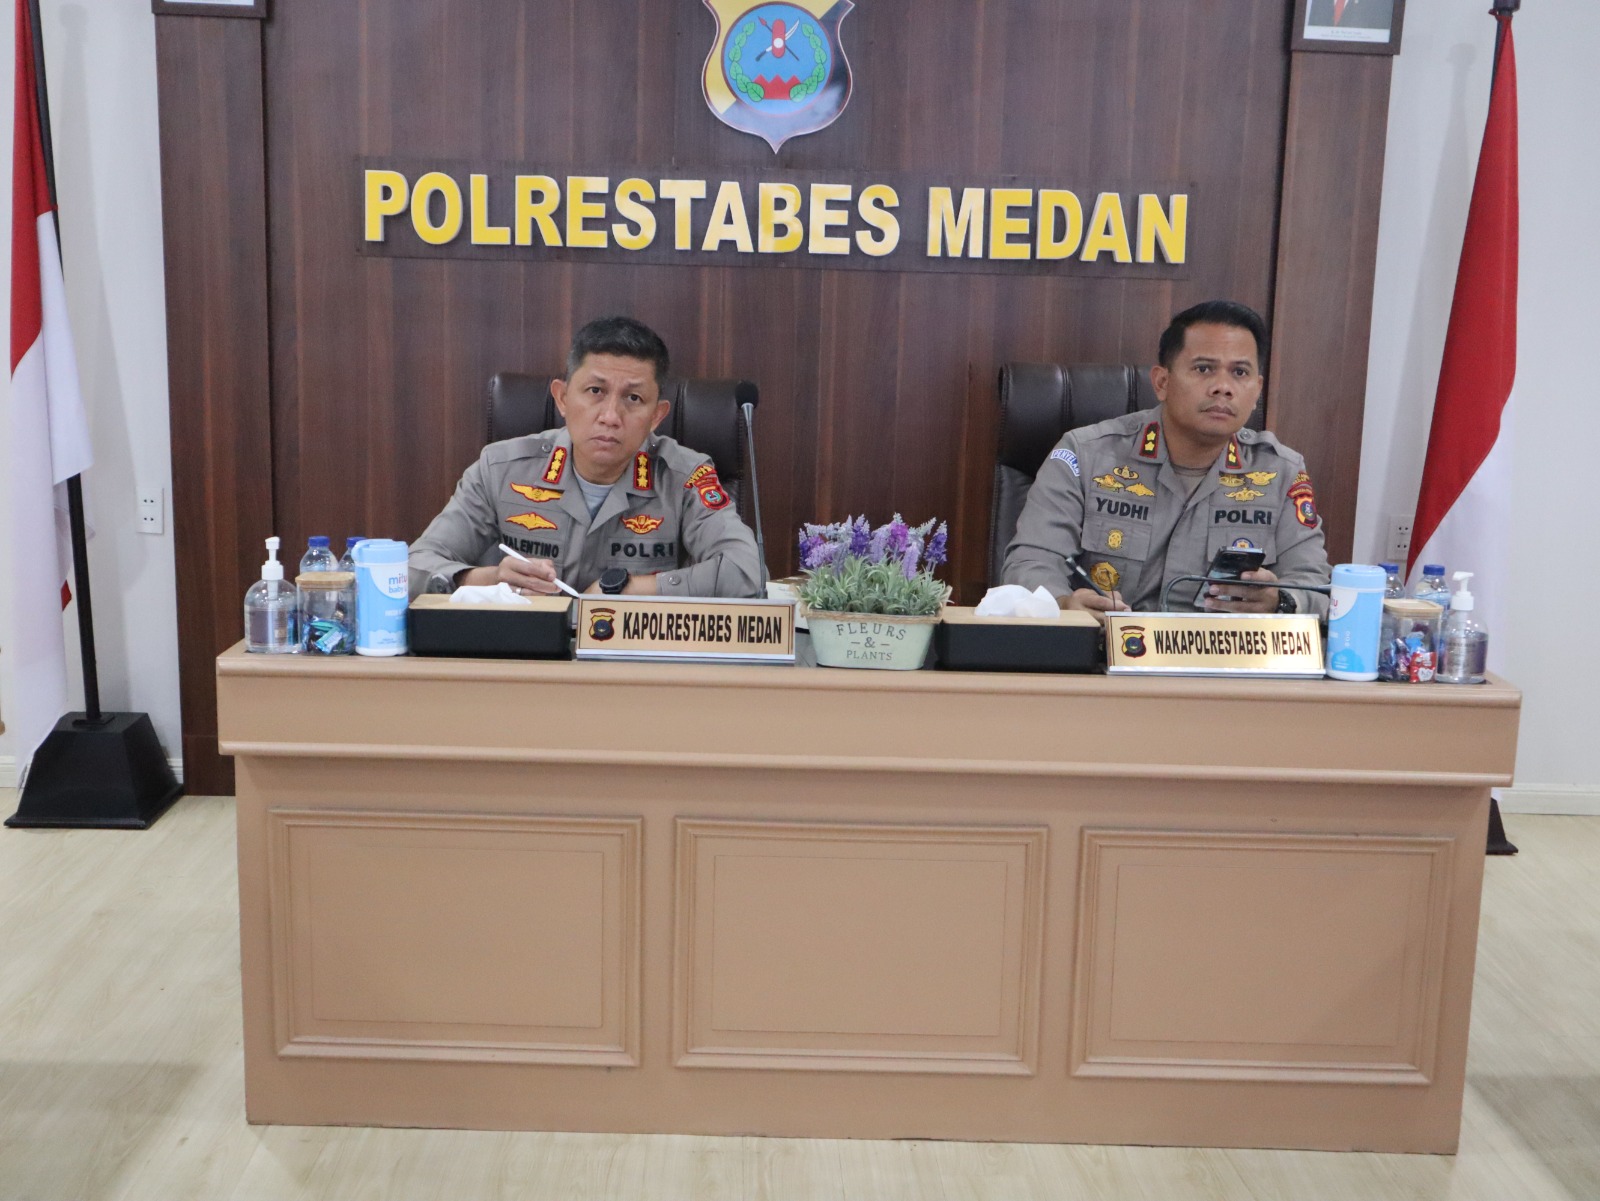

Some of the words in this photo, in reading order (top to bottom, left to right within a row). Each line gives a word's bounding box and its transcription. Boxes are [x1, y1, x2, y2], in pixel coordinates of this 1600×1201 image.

[364, 169, 901, 257] POLRESTABES
[926, 186, 1188, 264] MEDAN
[1096, 497, 1149, 521] YUDHI
[1214, 509, 1272, 526] POLRI
[502, 533, 559, 558] VALENTINO
[610, 541, 674, 558] POLRI
[622, 612, 732, 643] KAPOLRESTABES
[737, 615, 782, 644] MEDAN
[836, 622, 907, 641] FLEURS
[846, 649, 893, 661] PLANTS
[1153, 630, 1268, 655] WAKAPOLRESTABES
[1271, 631, 1312, 656] MEDAN
